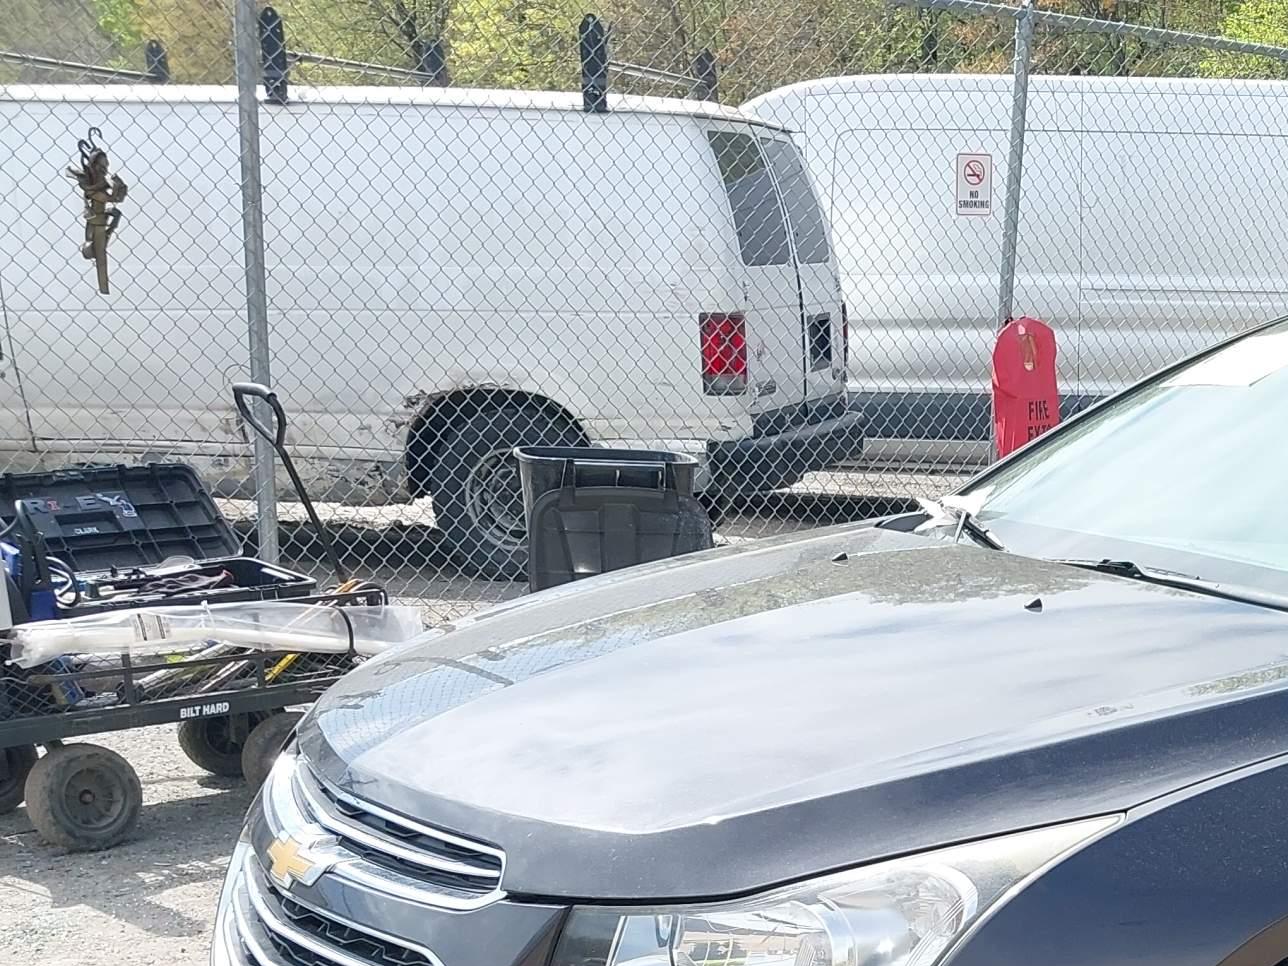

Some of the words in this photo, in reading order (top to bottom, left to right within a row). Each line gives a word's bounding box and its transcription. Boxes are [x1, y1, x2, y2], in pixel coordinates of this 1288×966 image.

[969, 190, 979, 199] NO
[958, 200, 990, 208] SMOKING
[180, 705, 201, 719] BILT
[202, 701, 230, 716] HARD
